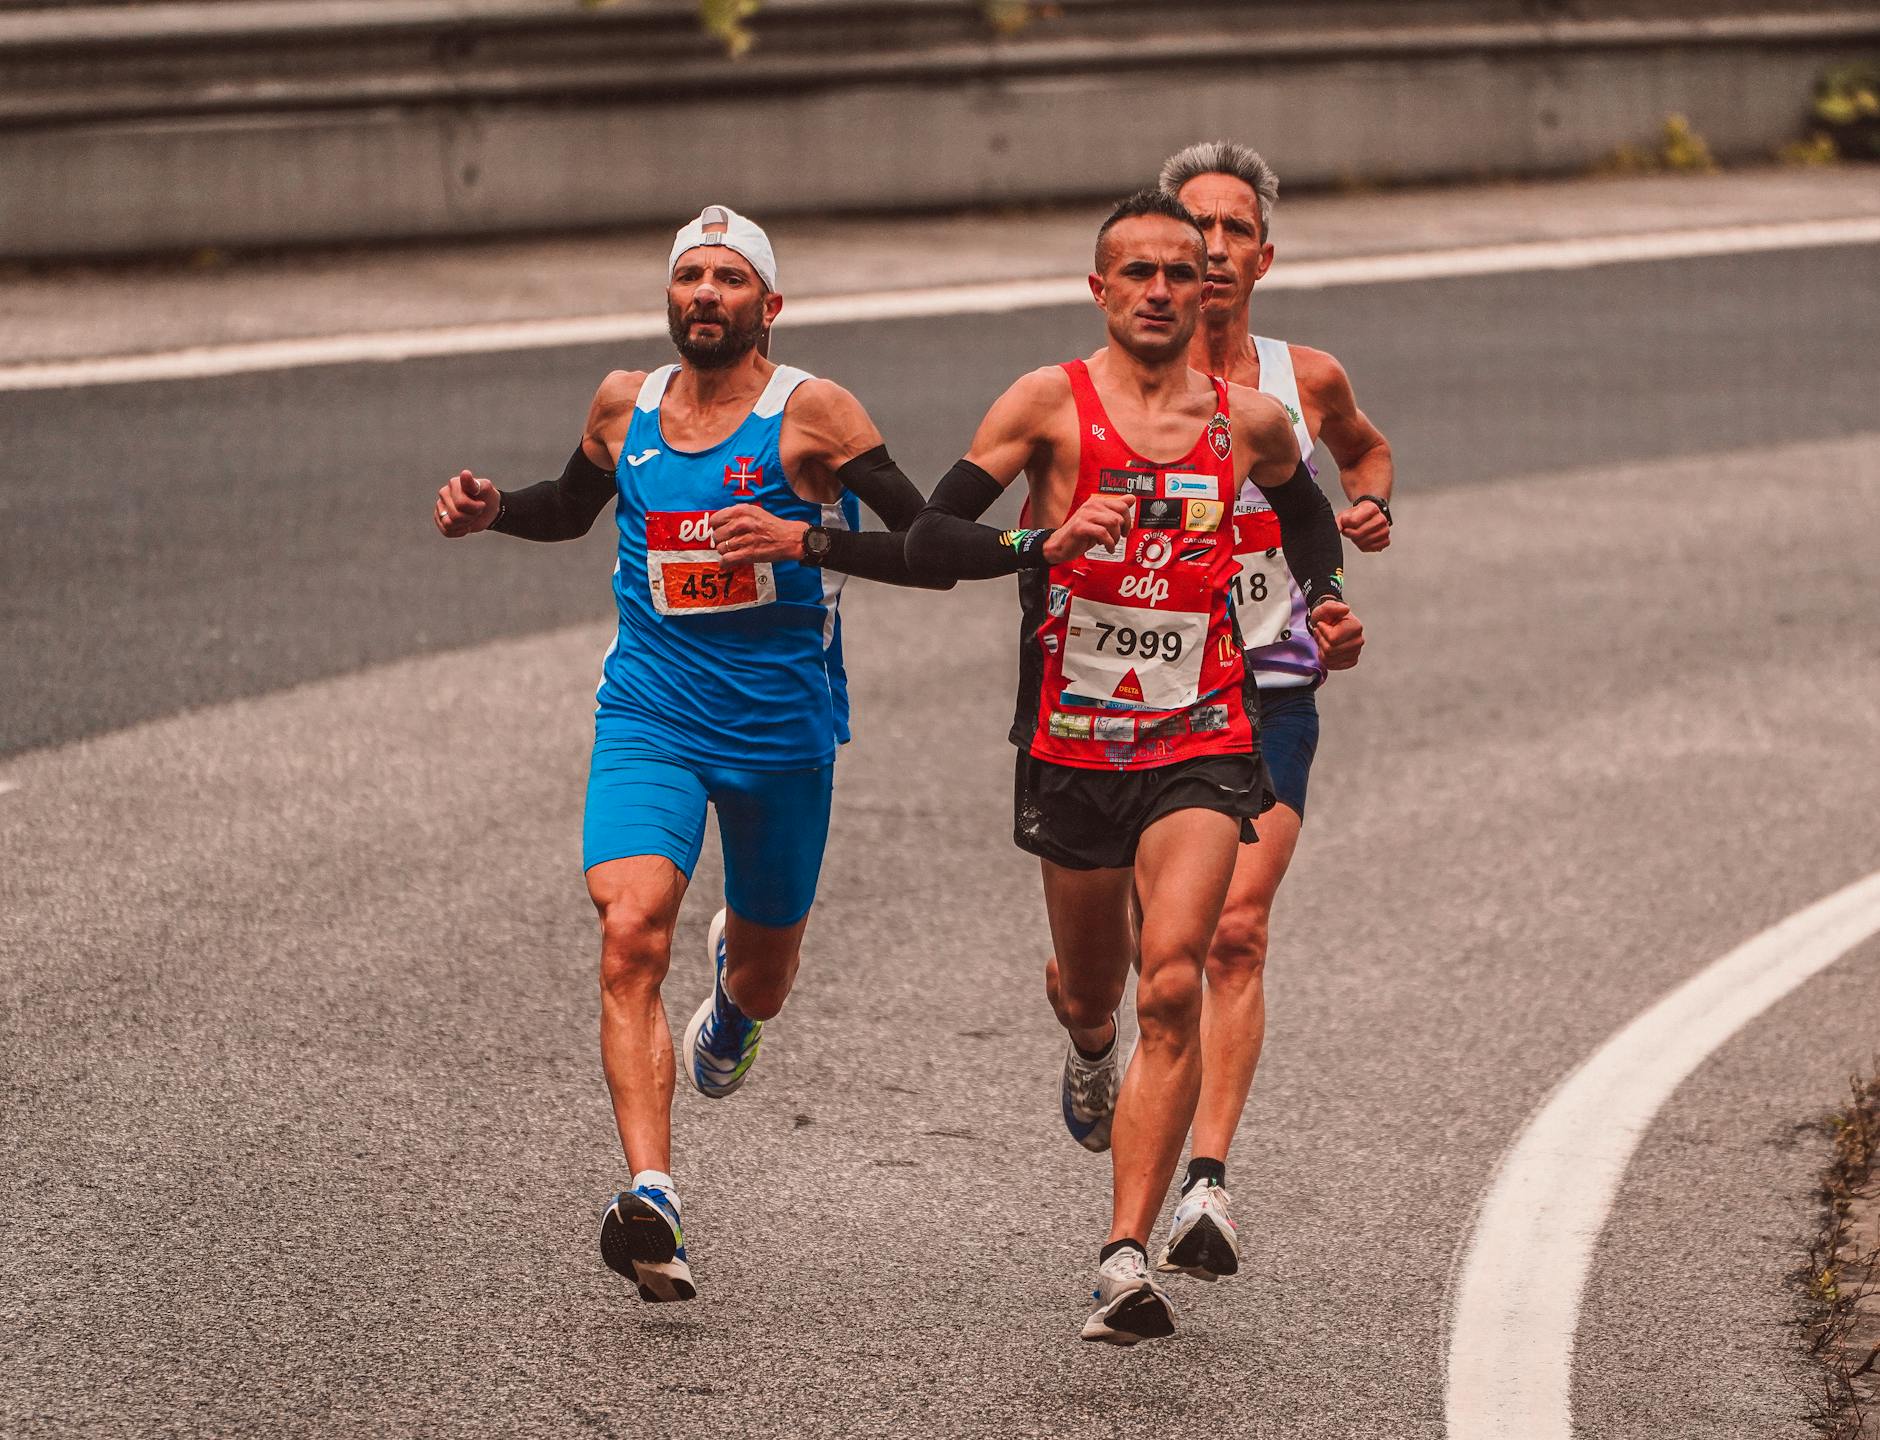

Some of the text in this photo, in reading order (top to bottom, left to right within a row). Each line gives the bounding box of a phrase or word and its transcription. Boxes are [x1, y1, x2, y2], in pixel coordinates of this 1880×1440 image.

[1143, 531, 1172, 543] Digital
[681, 571, 735, 600] 457
[1118, 570, 1169, 608] edp
[1095, 622, 1182, 662] 7999
[1119, 685, 1140, 695] DELTA
